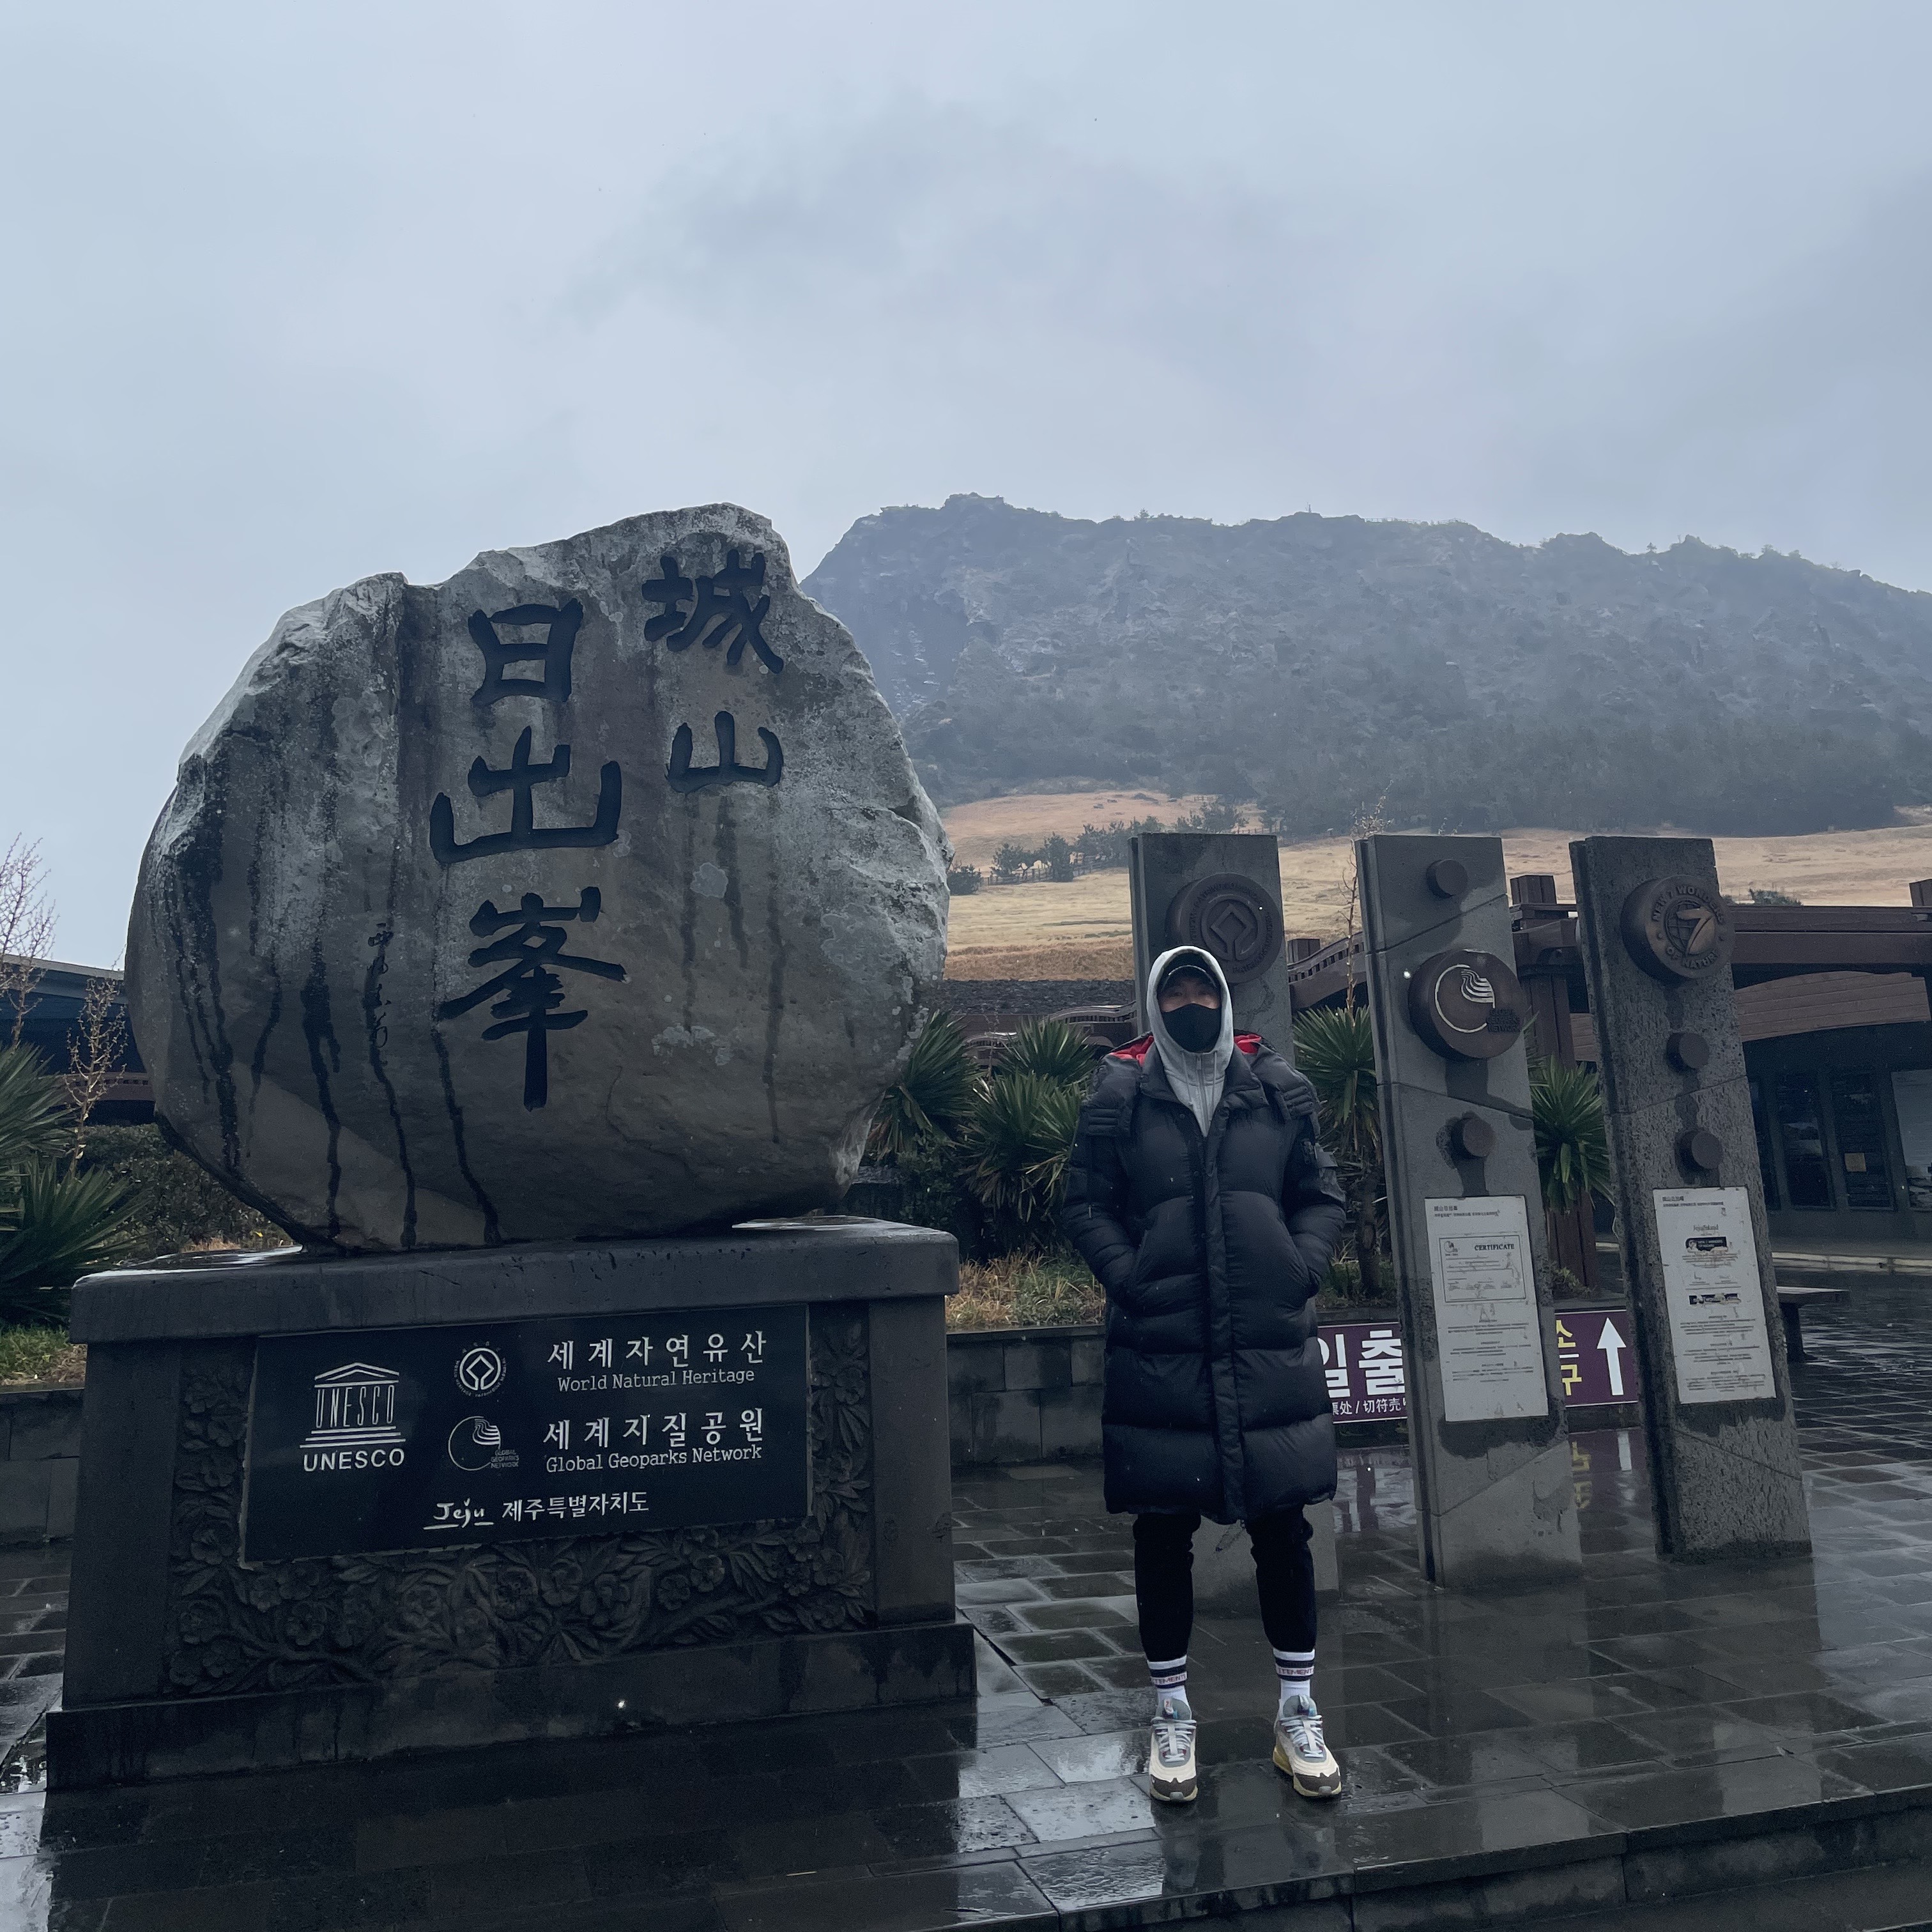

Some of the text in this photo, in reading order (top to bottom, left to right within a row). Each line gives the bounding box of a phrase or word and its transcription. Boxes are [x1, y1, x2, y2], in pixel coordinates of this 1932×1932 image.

[641, 548, 784, 793] 城山
[558, 1369, 755, 1392] World Natural Heritage
[316, 1384, 395, 1429] UNESCO
[1363, 1397, 1406, 1414] 切符売
[303, 1448, 405, 1472] UNESCO
[546, 1445, 763, 1473] Global Geoparks Network
[433, 1492, 650, 1528] Jeju 제주특별자치도
